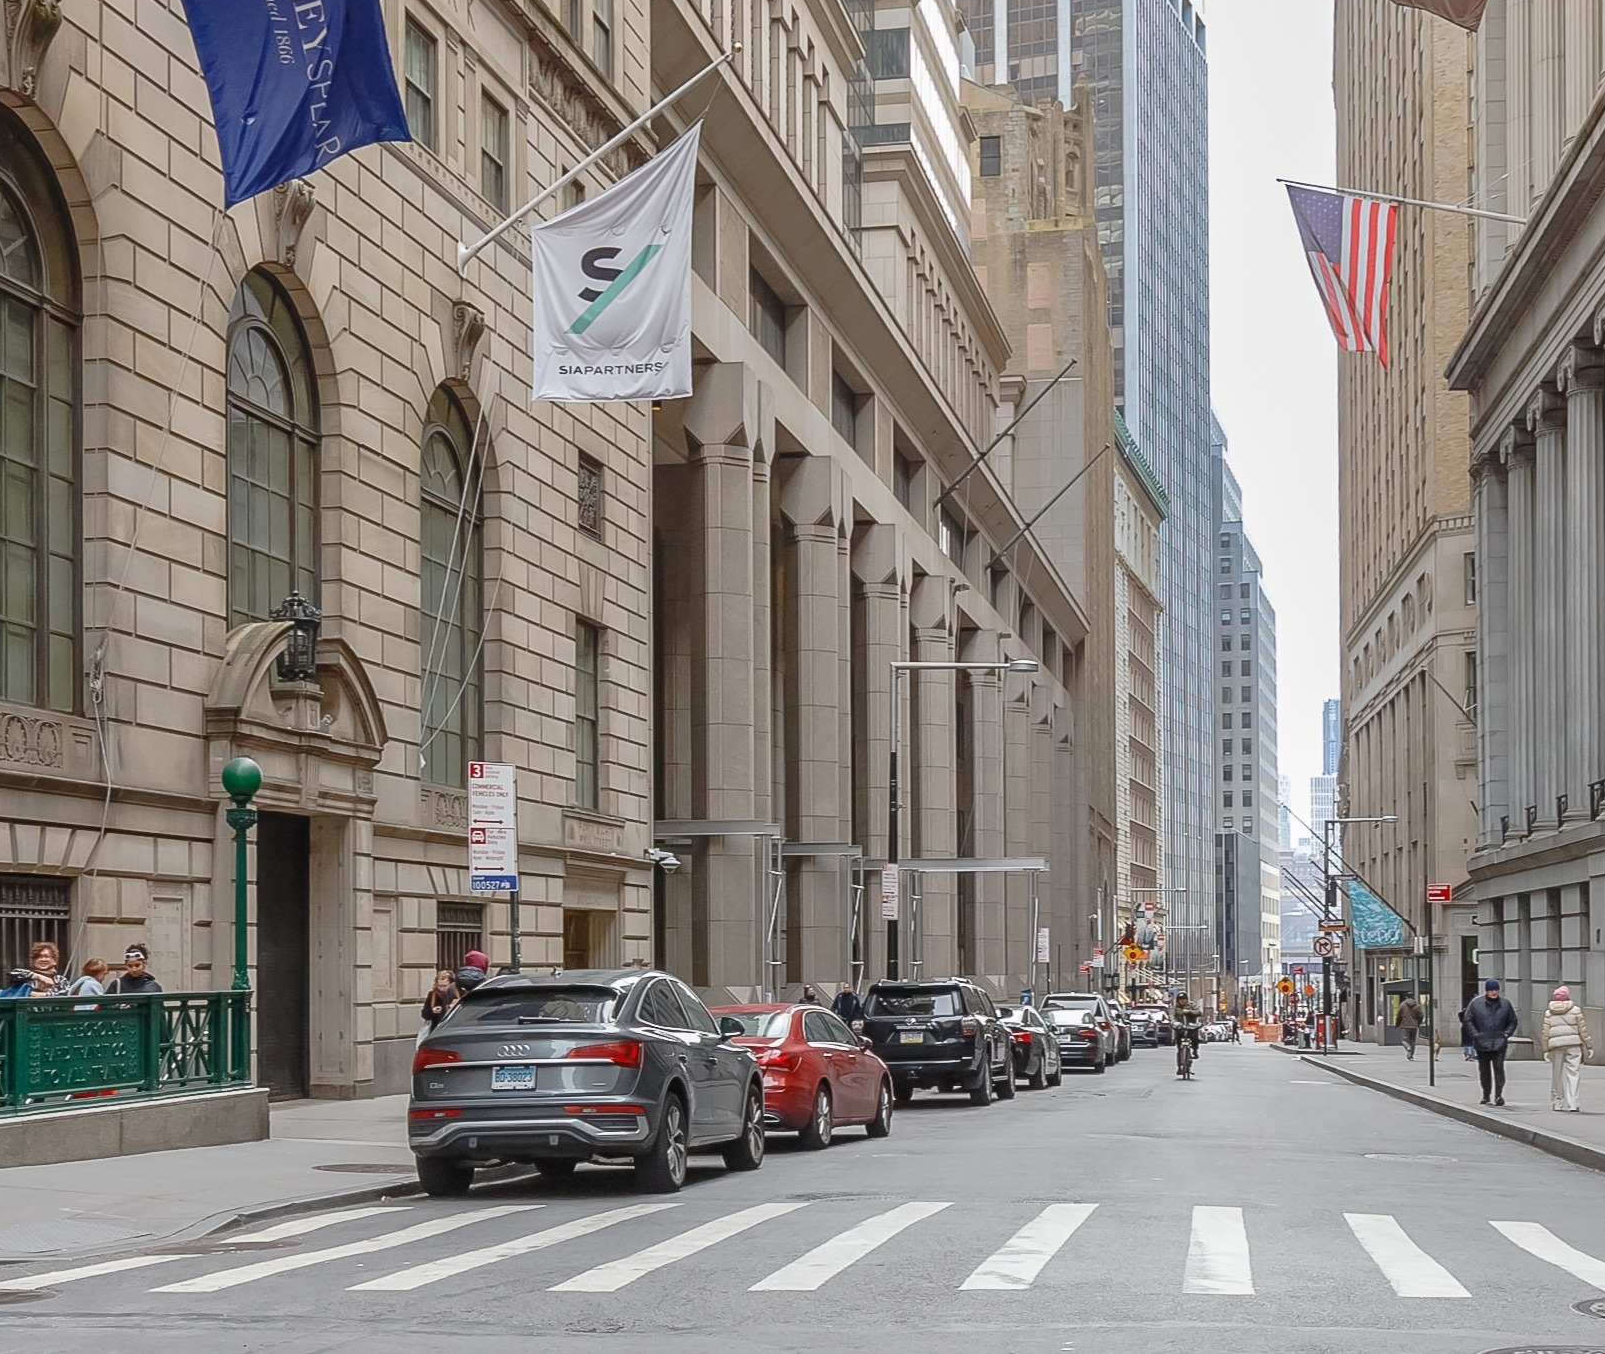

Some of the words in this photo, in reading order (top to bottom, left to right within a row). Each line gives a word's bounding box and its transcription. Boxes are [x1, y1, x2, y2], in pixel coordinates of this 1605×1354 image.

[273, 28, 295, 65] 1866
[558, 361, 664, 376] SIAPARTNERS
[472, 764, 481, 778] 3
